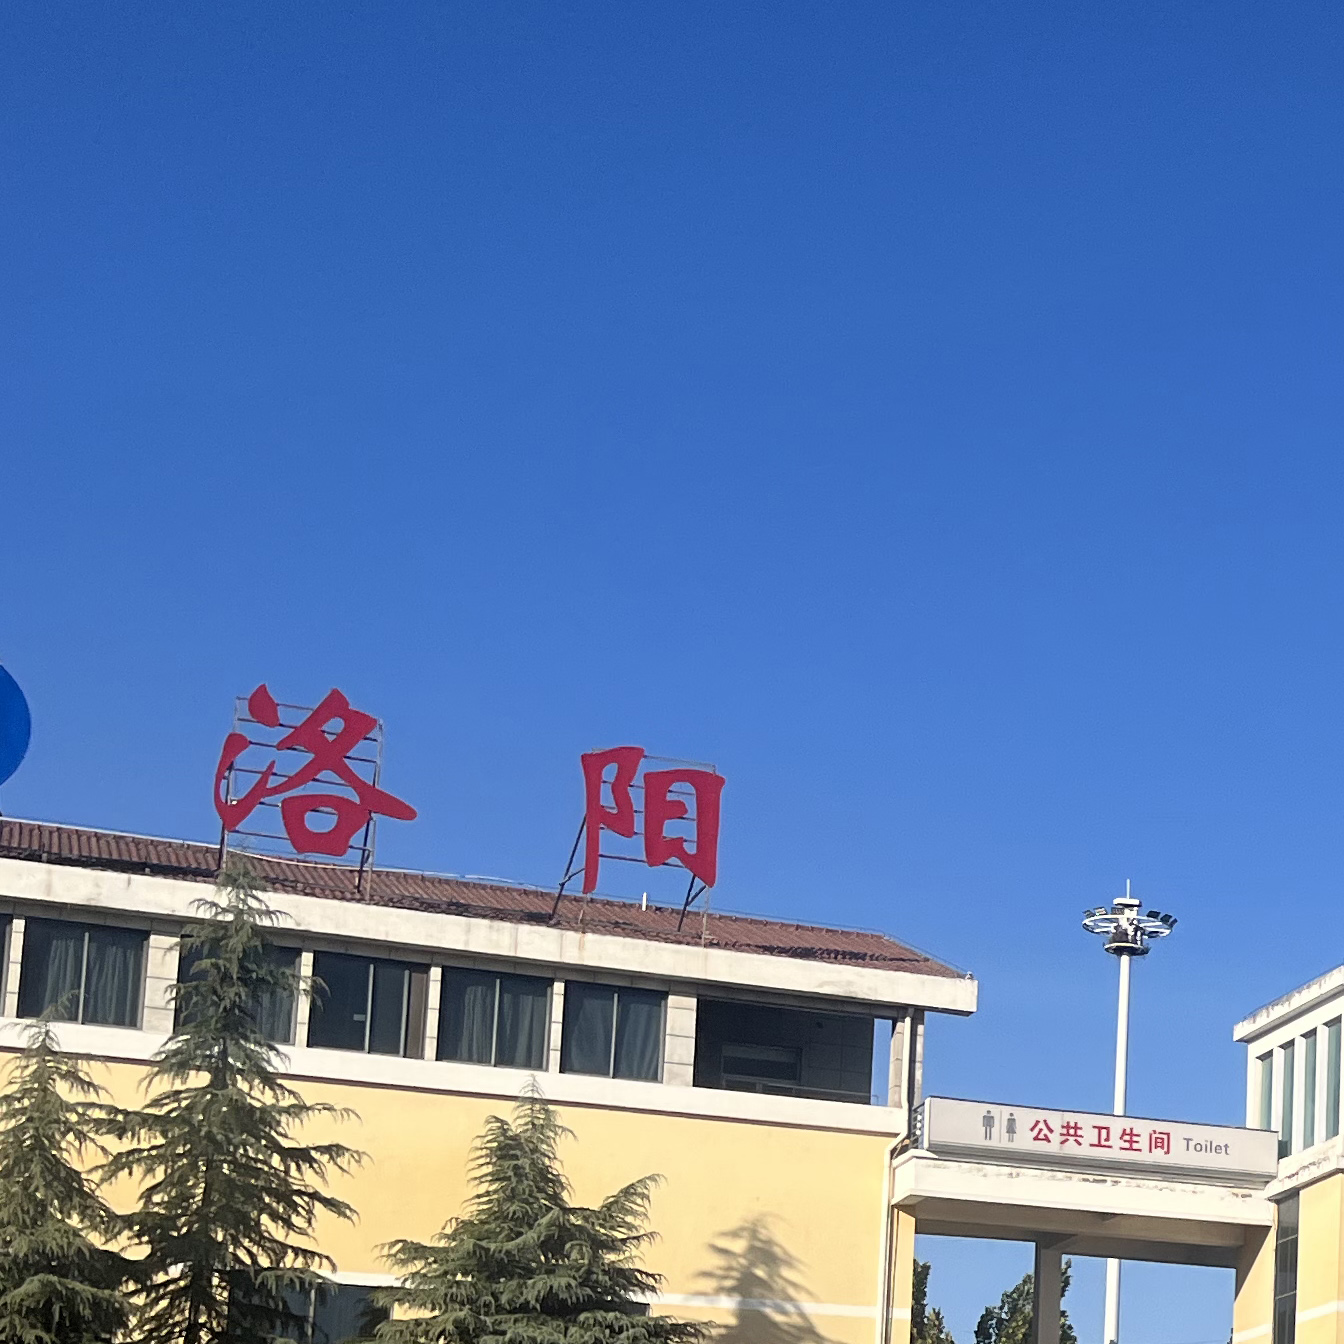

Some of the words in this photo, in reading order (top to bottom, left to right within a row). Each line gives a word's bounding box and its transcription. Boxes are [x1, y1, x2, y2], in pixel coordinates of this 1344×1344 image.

[214, 683, 725, 894] 洛阳
[1030, 1118, 1171, 1156] 公共卫生间
[1182, 1137, 1230, 1156] Toilet
